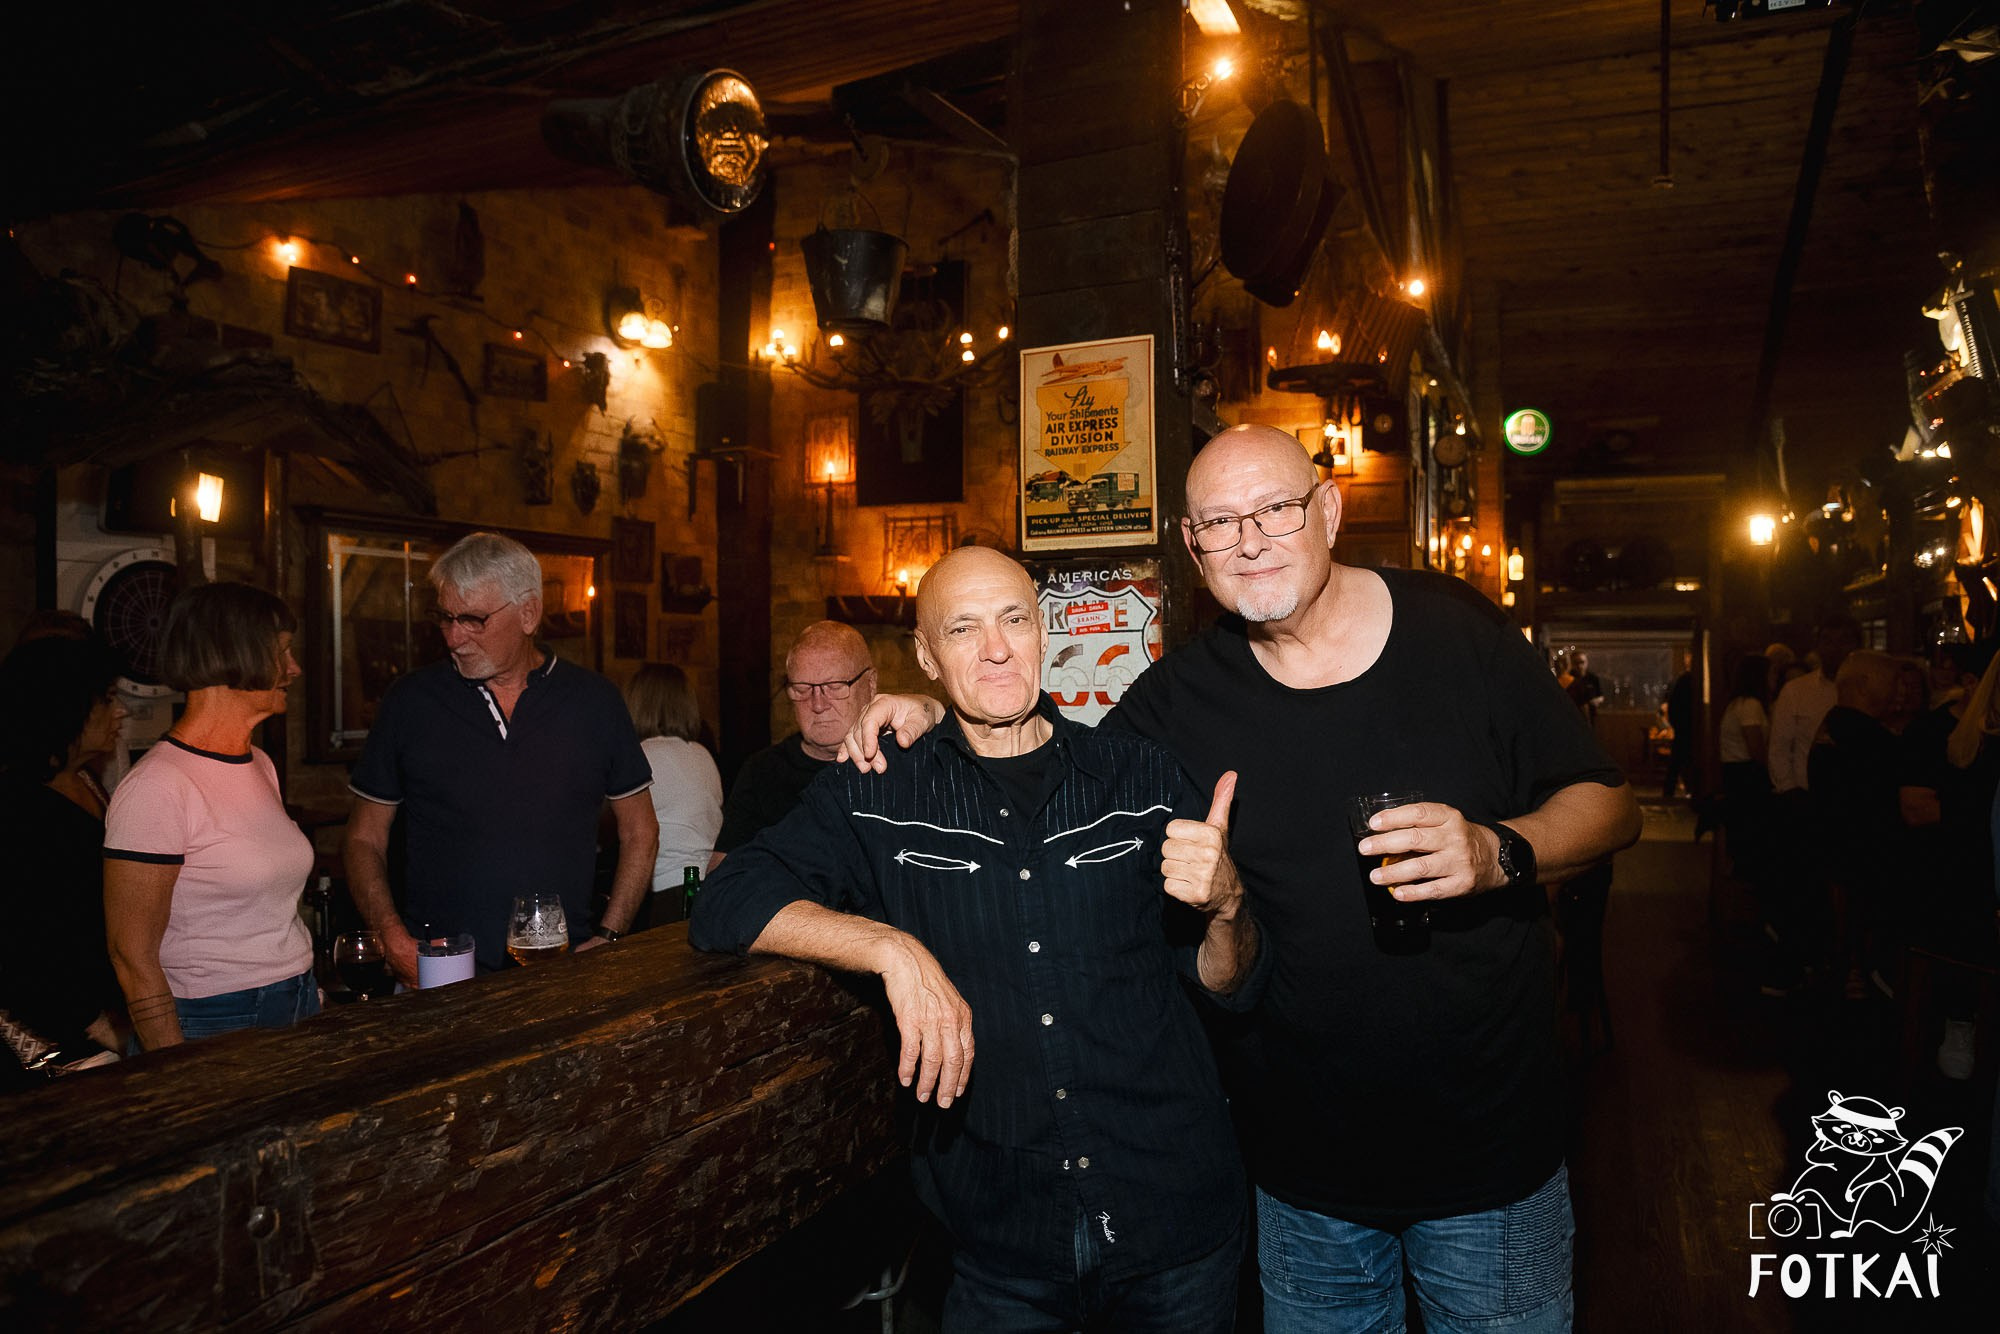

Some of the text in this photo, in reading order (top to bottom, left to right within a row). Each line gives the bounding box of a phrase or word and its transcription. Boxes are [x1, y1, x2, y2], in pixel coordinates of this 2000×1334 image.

[1064, 385, 1095, 410] Fly
[1046, 405, 1119, 422] Your Shipments
[1045, 417, 1119, 434] AIR EXPRESS
[1051, 431, 1113, 446] DIVISION
[1045, 443, 1119, 457] RAILWAY EXPRESS
[1077, 514, 1110, 522] SPECIAL
[1112, 511, 1150, 520] DELIVERY
[1047, 567, 1134, 584] AMERICA'S
[1047, 642, 1137, 713] 66
